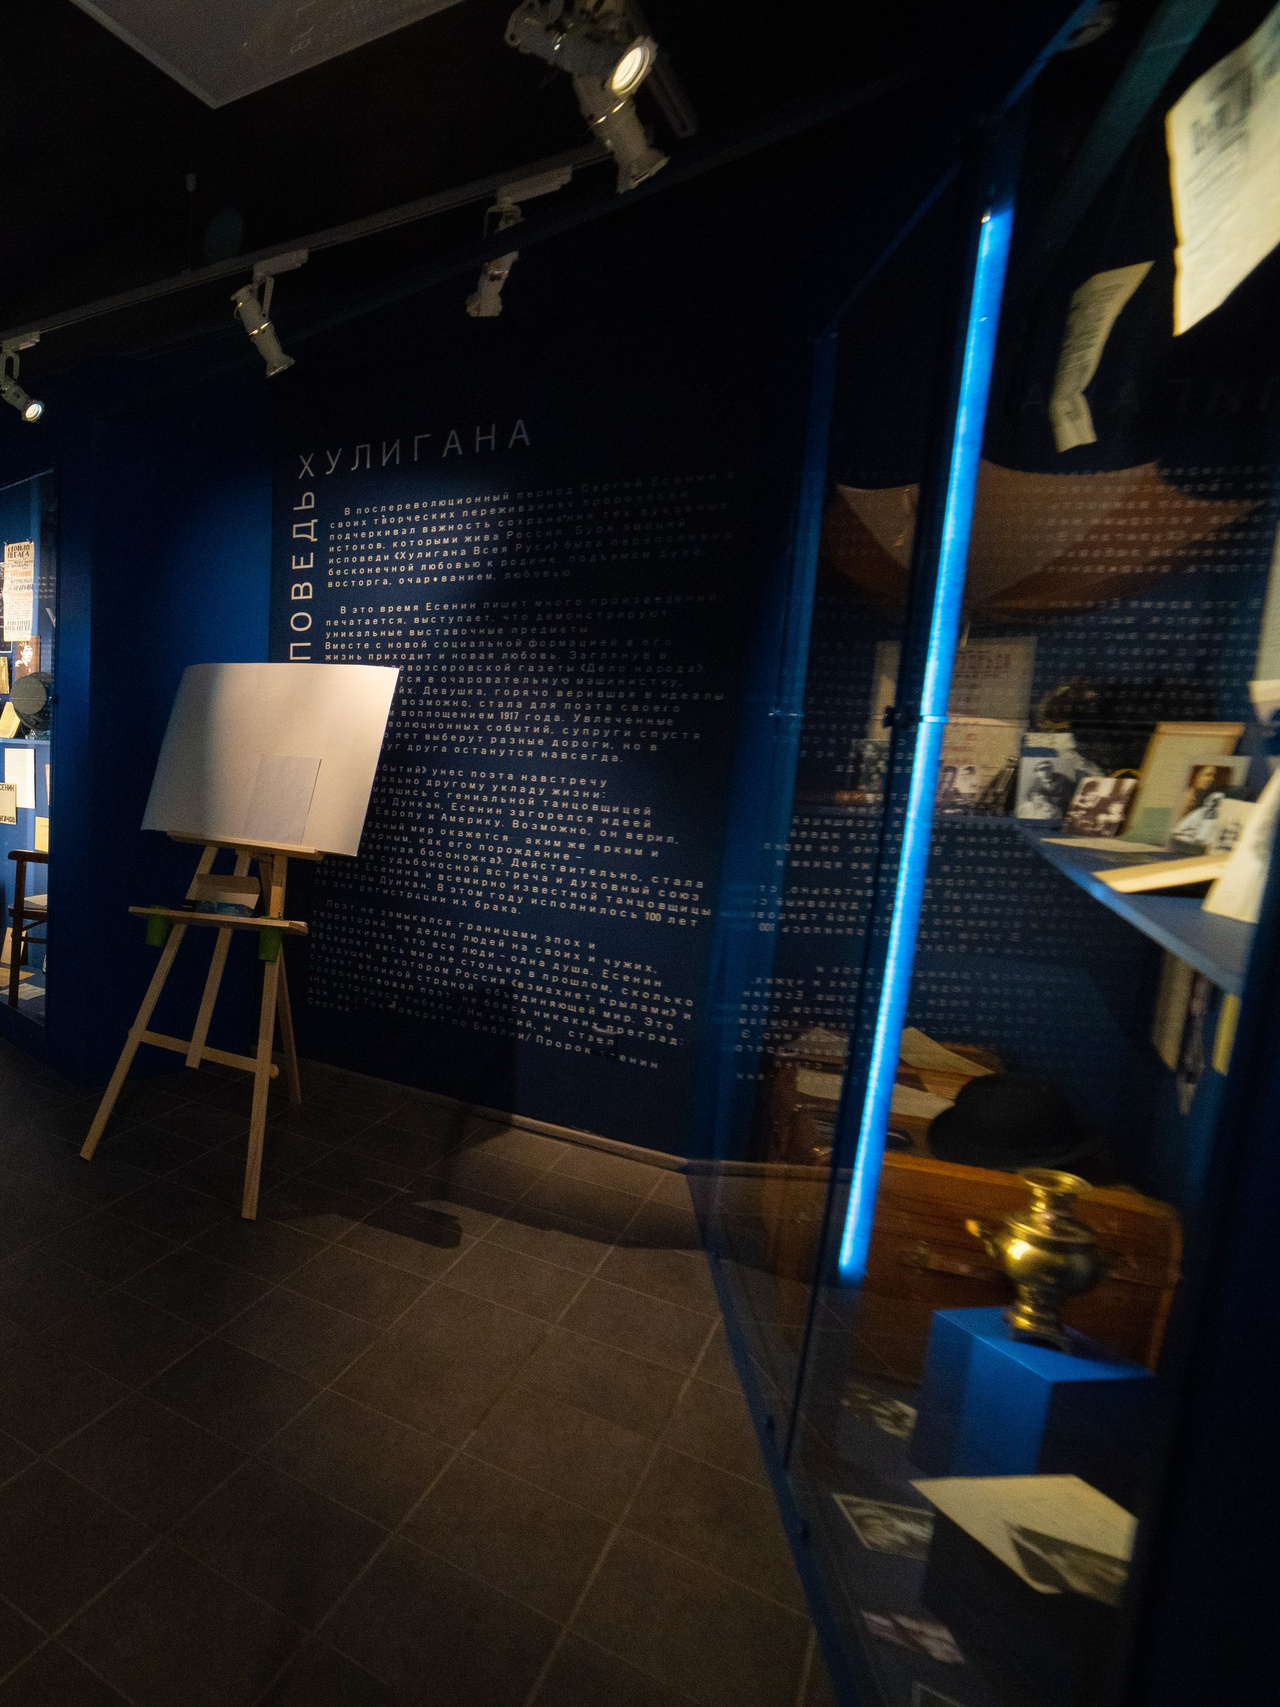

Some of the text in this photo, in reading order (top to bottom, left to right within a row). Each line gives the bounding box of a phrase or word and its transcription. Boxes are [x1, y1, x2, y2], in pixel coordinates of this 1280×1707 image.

[297, 417, 531, 480] ХУЛИГАНА
[344, 492, 509, 516] В послереволюционный
[330, 512, 454, 529] своих творческих
[329, 522, 490, 540] подчеркивал важность
[393, 537, 458, 547] которыми
[464, 534, 499, 542] жива
[329, 555, 389, 564] исповеди
[473, 546, 507, 555] Всея
[289, 491, 319, 662] ПОВЕДЬ
[328, 563, 414, 576] бесконечной
[421, 561, 480, 570] любовью
[340, 606, 346, 614] В
[380, 605, 419, 613] время
[426, 602, 476, 611] Есенин
[483, 601, 527, 609] пишет
[534, 599, 582, 607] много
[326, 626, 591, 639] уникальные выставочные предметы.
[325, 642, 369, 650] Вместе
[388, 640, 427, 648] новой
[434, 639, 522, 648] социальной
[528, 638, 617, 648] формацией
[569, 650, 650, 661] Заглянув
[441, 677, 569, 686] очаровательную
[423, 686, 635, 698] Девушка, горячо верившая
[564, 703, 612, 711] поэта
[621, 704, 680, 713] своего
[401, 710, 673, 726] воплощением 1917 года. Увлеченные
[425, 733, 483, 743] выберут
[490, 737, 544, 745] разные
[562, 727, 631, 737] супруги
[640, 731, 700, 740] спустя
[407, 744, 623, 762] друга останутся навсегда.
[432, 769, 607, 788] унес поэта навстречу
[426, 779, 606, 798] другому укладу жизни:
[447, 792, 651, 815] гениальной танцовщицей
[440, 813, 504, 827] Америку.
[451, 802, 651, 828] Есенин загорелся идеей
[440, 829, 643, 855] окажется ярким
[479, 844, 570, 860] порождение
[381, 856, 699, 901] судьбоносной встреча духовный союз
[511, 858, 704, 888] Действительно, стала
[438, 874, 711, 915] всемирно известной танцовщицы
[531, 898, 697, 927] исполнилось 100 лет
[327, 899, 580, 947] Поэт замыкался границами эпох
[416, 927, 580, 960] делил людей своих
[394, 959, 505, 984] котором Россия
[462, 947, 662, 987] люди Есенин
[461, 959, 693, 1007] столько сколько
[644, 1017, 674, 1030] Это
